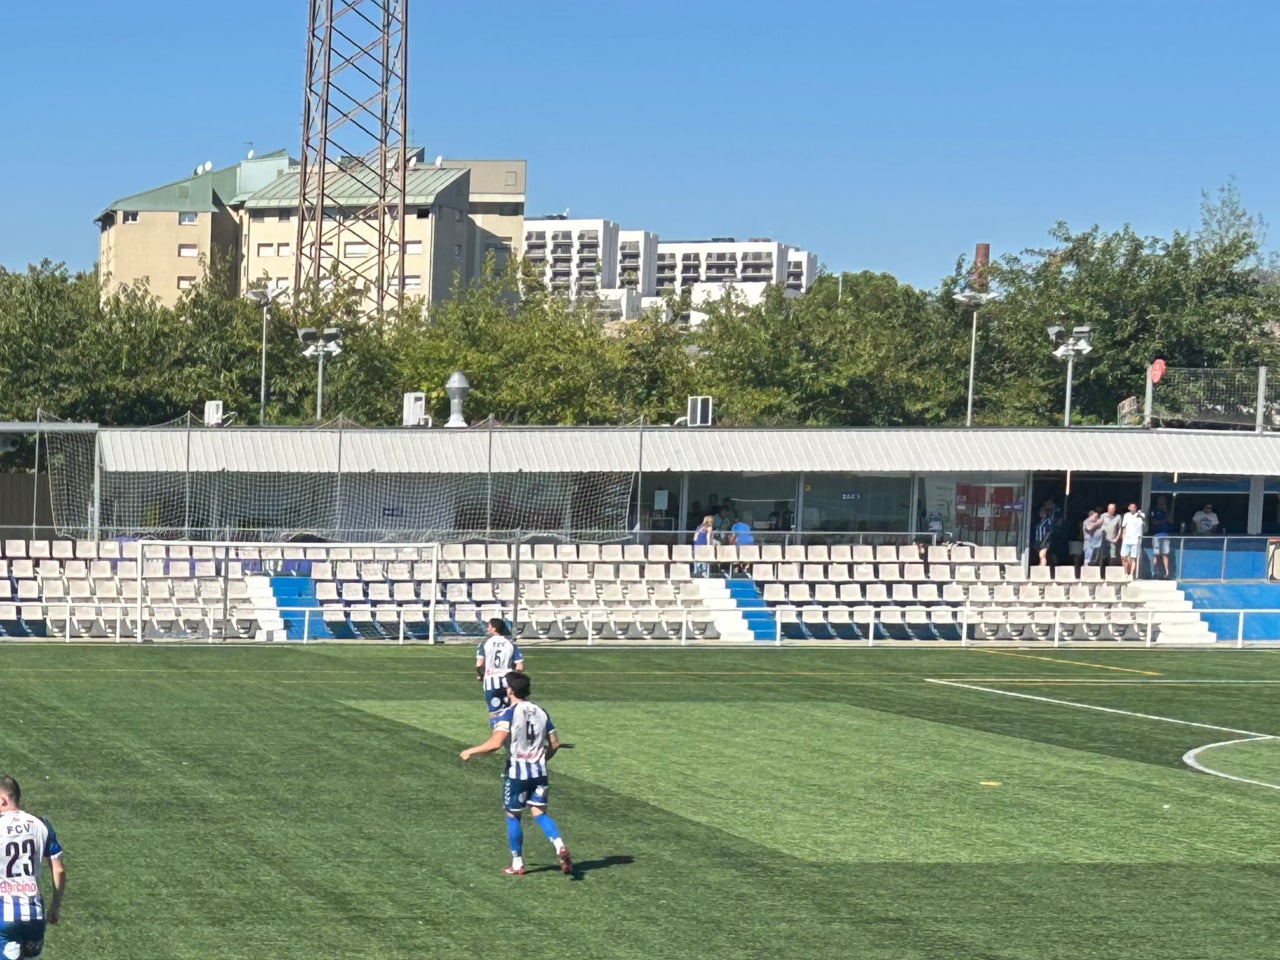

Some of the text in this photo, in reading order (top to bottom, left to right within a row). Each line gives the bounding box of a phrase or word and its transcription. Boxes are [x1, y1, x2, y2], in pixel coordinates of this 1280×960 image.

[526, 720, 536, 745] 4
[6, 823, 31, 835] FCV
[5, 838, 36, 878] 23
